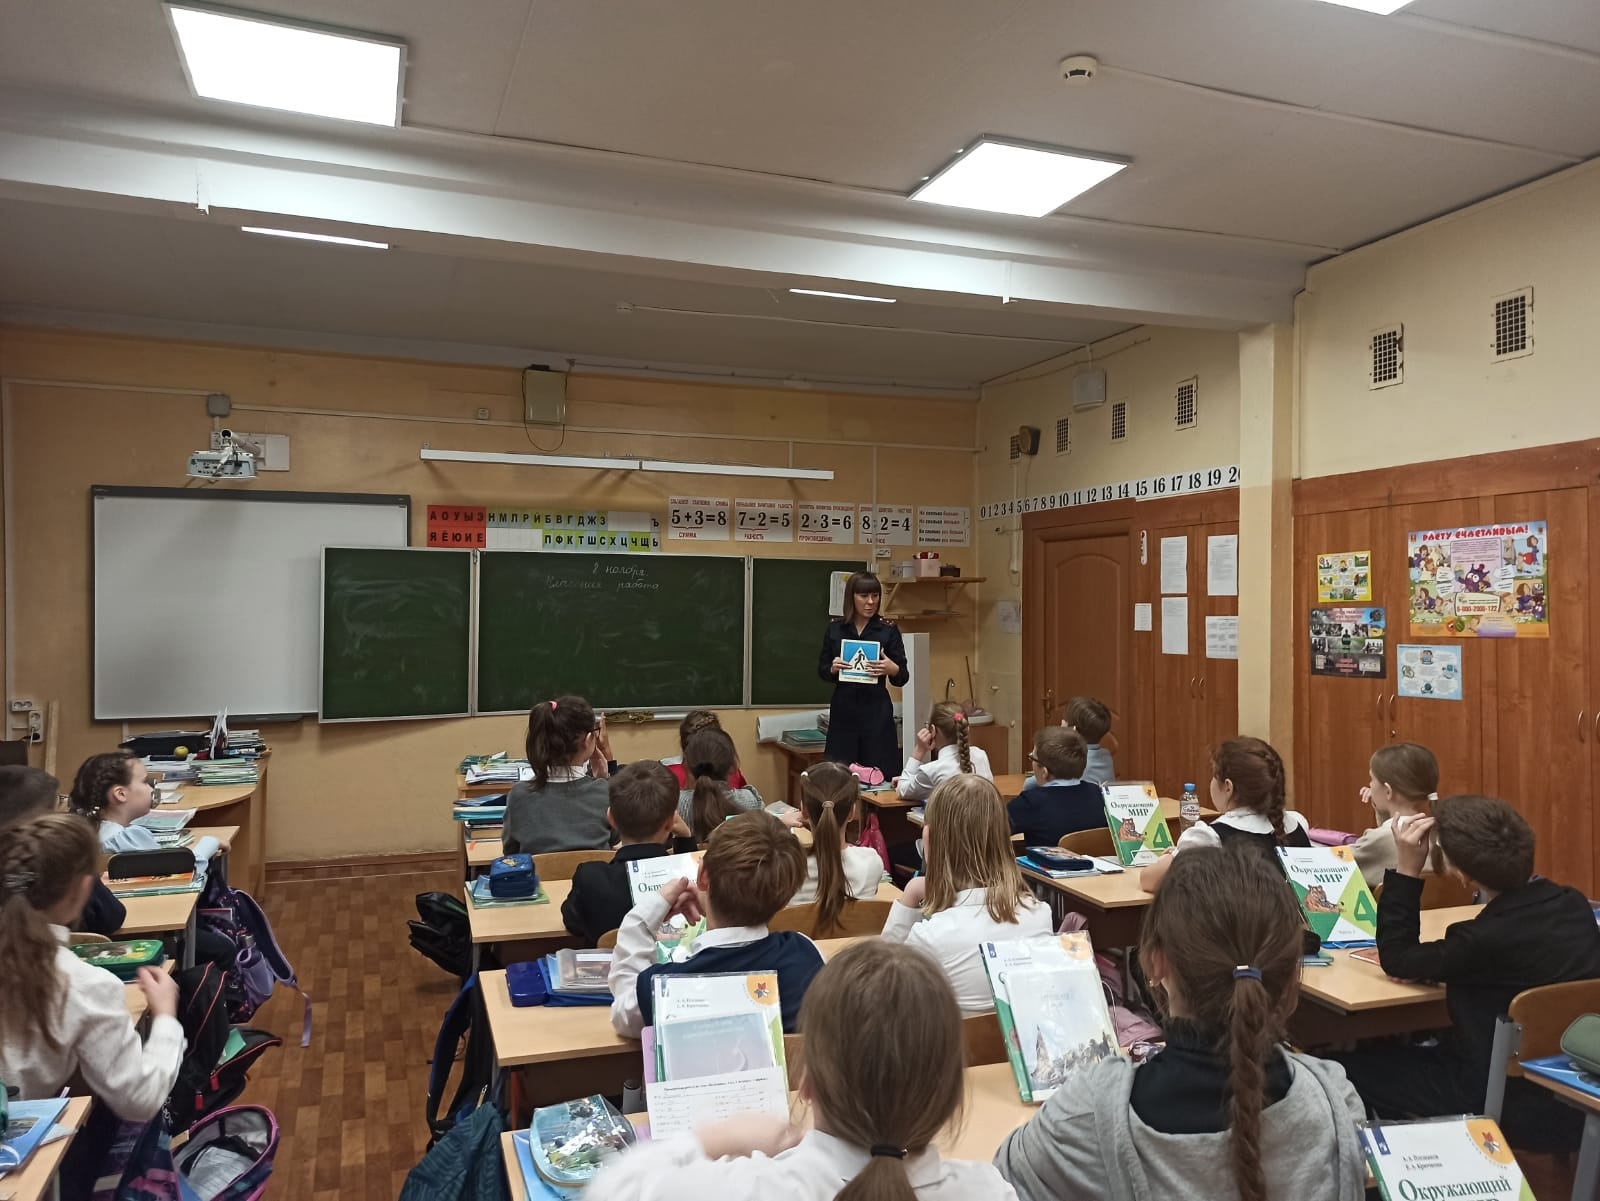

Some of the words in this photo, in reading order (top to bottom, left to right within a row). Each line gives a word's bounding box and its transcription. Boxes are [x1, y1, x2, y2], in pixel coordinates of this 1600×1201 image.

[981, 506, 986, 518] 0
[988, 506, 992, 517] 1
[994, 504, 999, 516] 2
[1001, 503, 1006, 516] 3
[1008, 502, 1013, 514] 4
[1017, 500, 1022, 512] 5
[1024, 499, 1030, 511] 6
[1033, 498, 1038, 510] 7
[1041, 497, 1046, 509] 8
[1050, 495, 1055, 508] 9
[1059, 493, 1069, 507] 10
[1073, 490, 1082, 505] 11
[1087, 488, 1097, 503] 12
[1102, 486, 1112, 500] 13
[1118, 483, 1129, 498] 14
[1136, 480, 1148, 496] 15
[1153, 477, 1165, 493] 16
[1171, 475, 1183, 491] 17
[1188, 472, 1201, 489] 18
[1207, 469, 1221, 487] 19
[1228, 466, 1240, 483] 2
[1422, 532, 1452, 541] РАСТУ
[1455, 525, 1529, 539] СЧАСТЛИВЫМ!
[593, 562, 599, 574] 8
[1128, 808, 1149, 816] МИР
[1153, 822, 1173, 849] 4
[1290, 864, 1349, 875] Окружающий
[1314, 874, 1343, 883] МИР
[1353, 890, 1376, 927] 4
[1398, 1175, 1512, 1201] Окружающий
